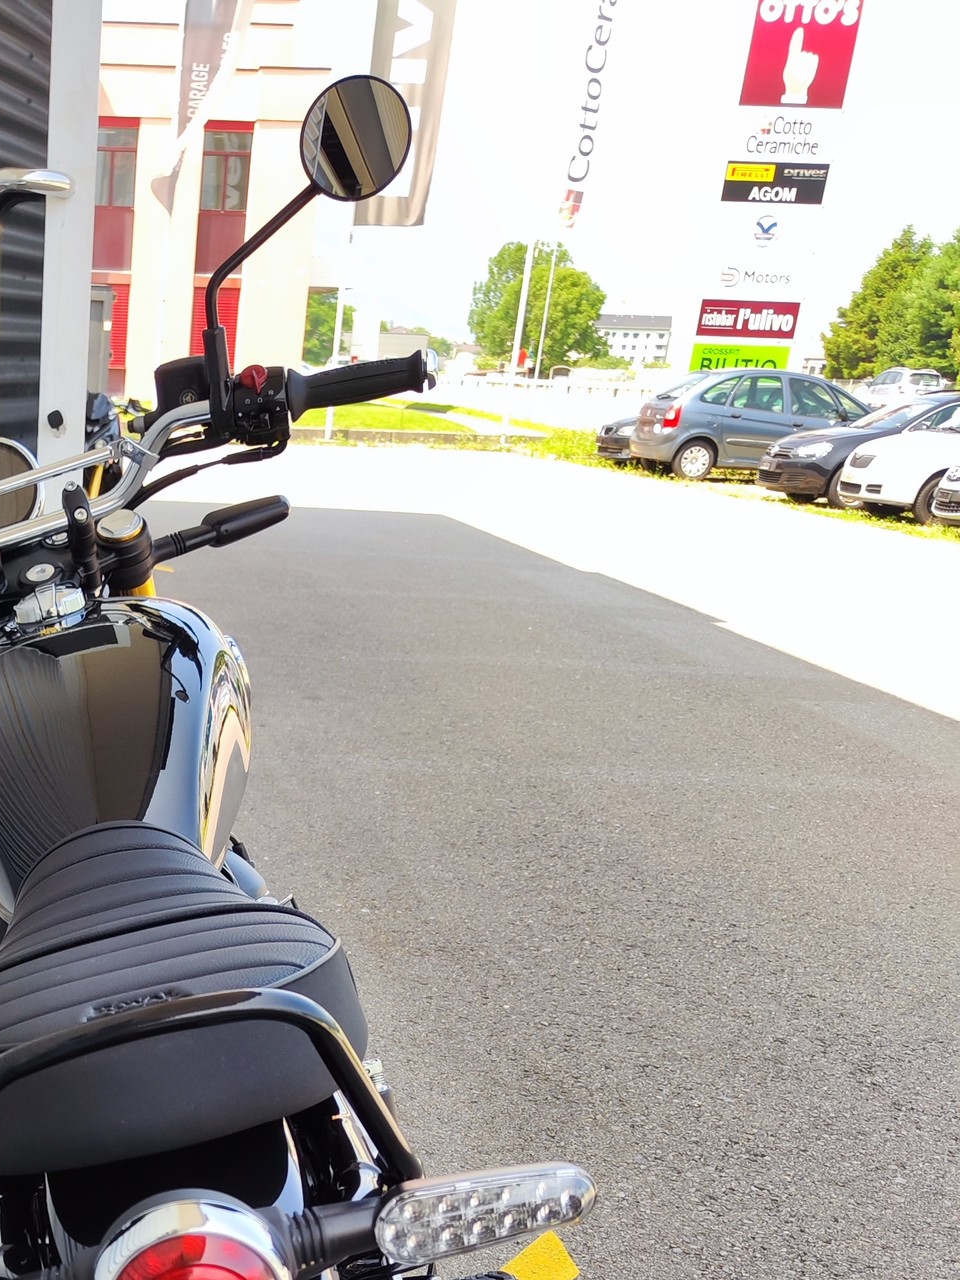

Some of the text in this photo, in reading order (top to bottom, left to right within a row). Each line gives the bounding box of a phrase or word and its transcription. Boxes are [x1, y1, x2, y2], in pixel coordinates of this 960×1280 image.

[568, 0, 617, 182] CottoCer
[774, 116, 812, 135] Cotto
[746, 135, 819, 155] Ceramiche
[730, 167, 770, 179] PIRELLI
[748, 186, 797, 202] AGOM
[743, 271, 790, 284] Motors
[701, 308, 794, 332] ristobar l'ulivo
[702, 347, 741, 356] CROSSFIT
